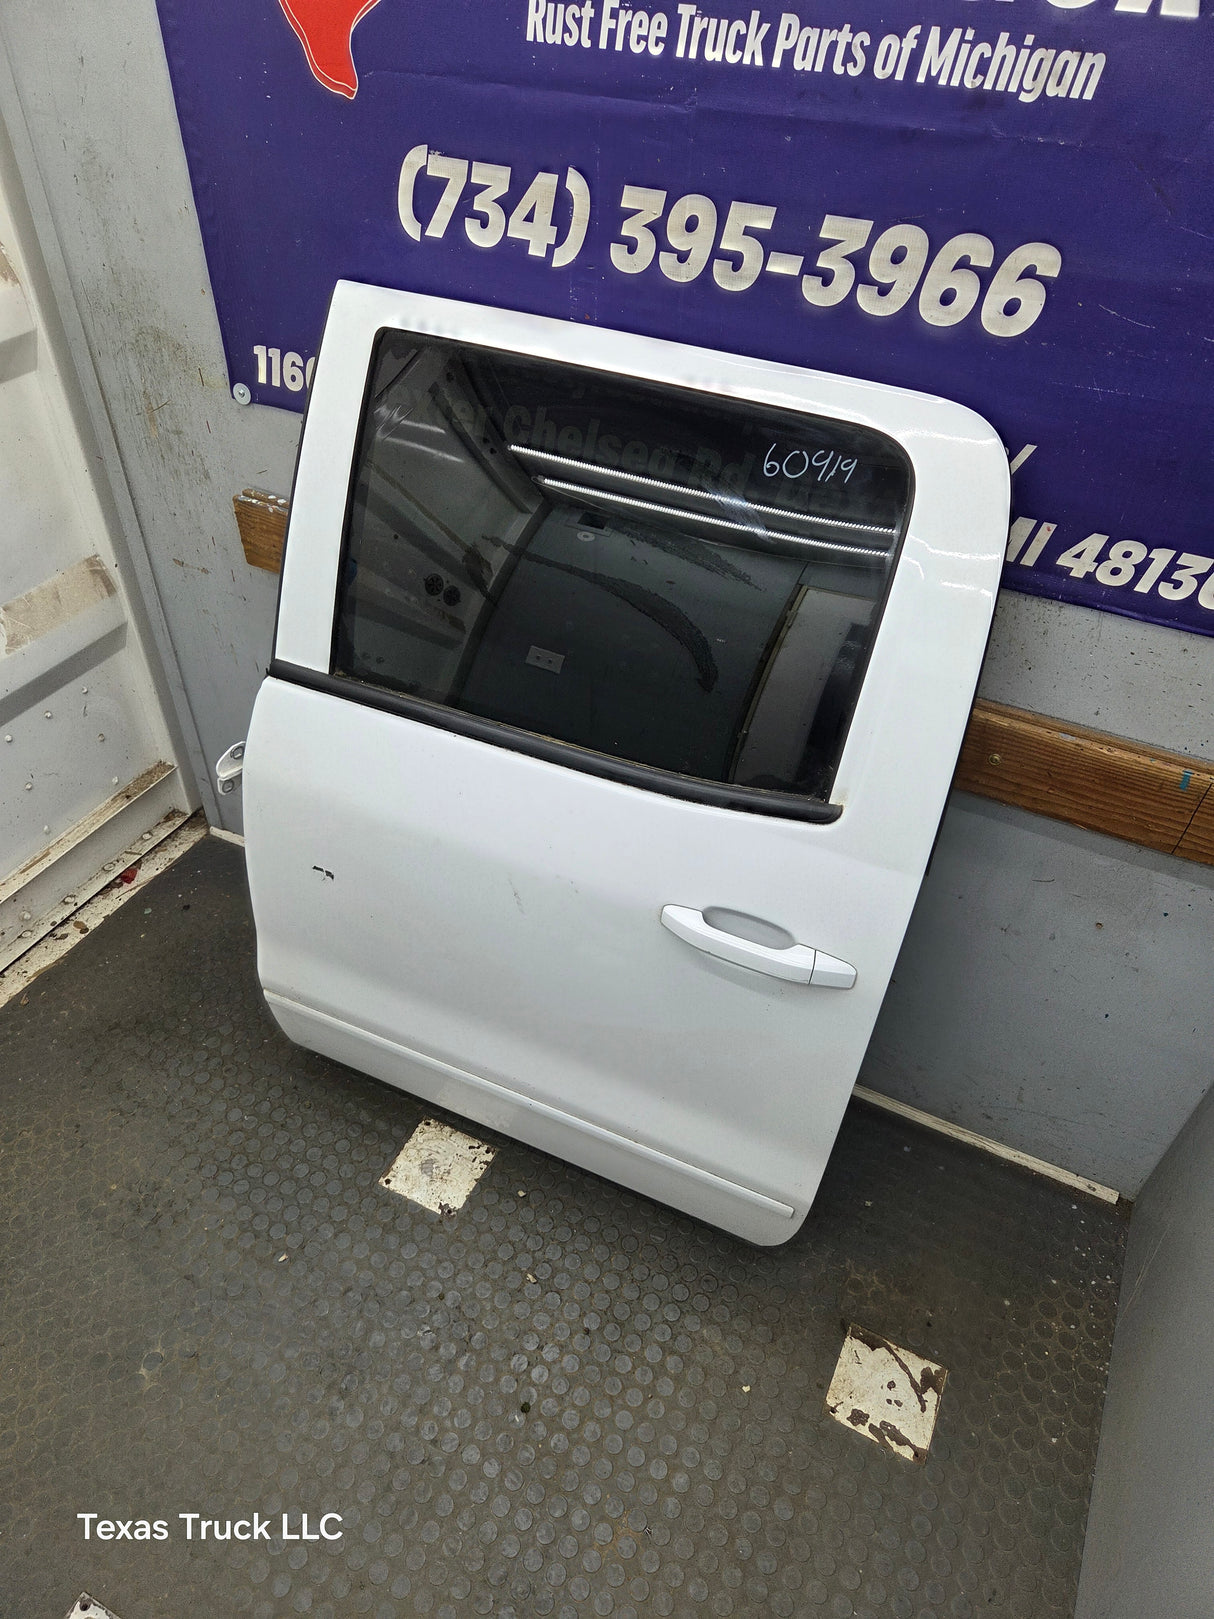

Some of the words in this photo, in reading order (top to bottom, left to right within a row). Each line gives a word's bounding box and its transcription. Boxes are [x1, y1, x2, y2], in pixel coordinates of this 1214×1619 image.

[526, 0, 594, 48] Rust
[599, 0, 668, 57] Free
[675, 3, 771, 67] Truck
[771, 12, 871, 77] Parts
[873, 25, 922, 81] of
[916, 25, 1107, 103] Michigan
[397, 144, 591, 268] (734)
[610, 184, 1062, 338] 395-3966
